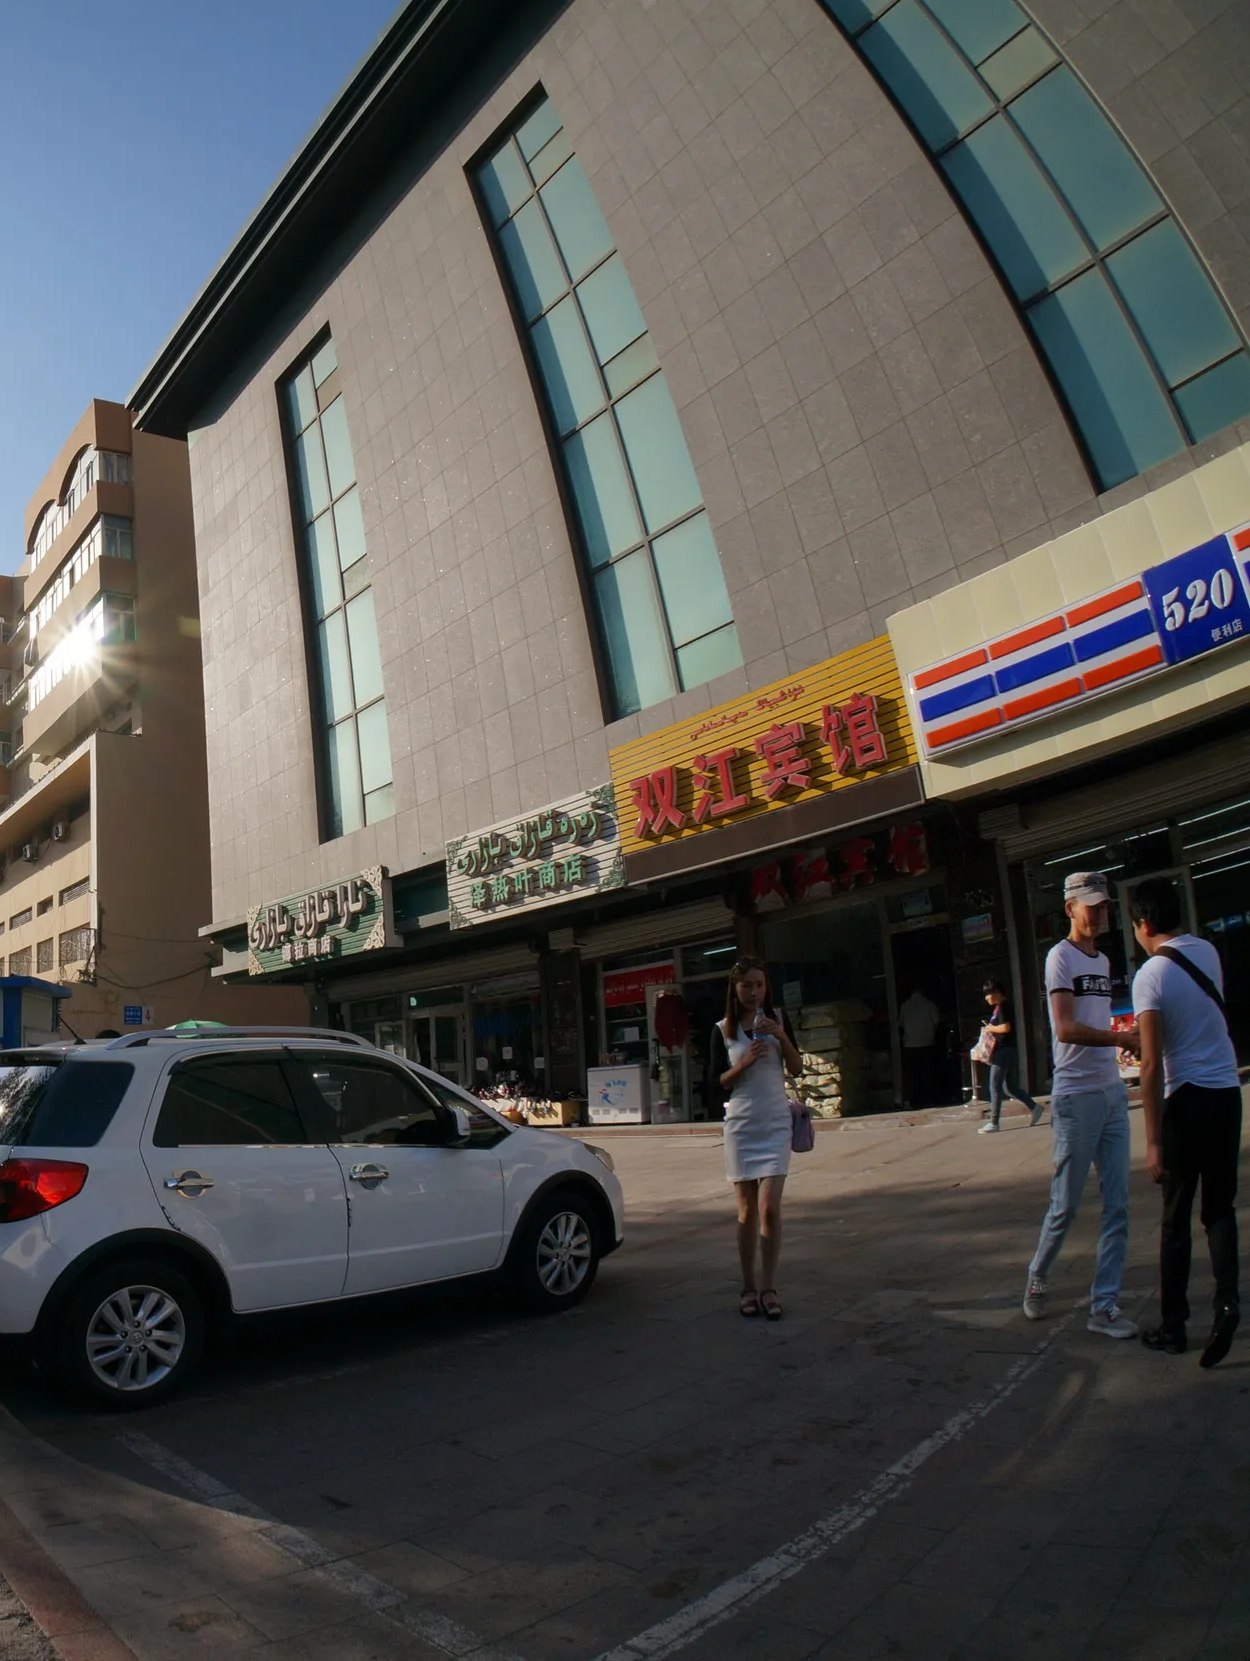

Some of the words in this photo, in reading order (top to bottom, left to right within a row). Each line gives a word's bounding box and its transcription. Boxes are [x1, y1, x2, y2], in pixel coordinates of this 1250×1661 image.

[1162, 568, 1233, 632] 520
[1211, 619, 1243, 642] 便利店
[630, 692, 888, 838] 双江宾馆
